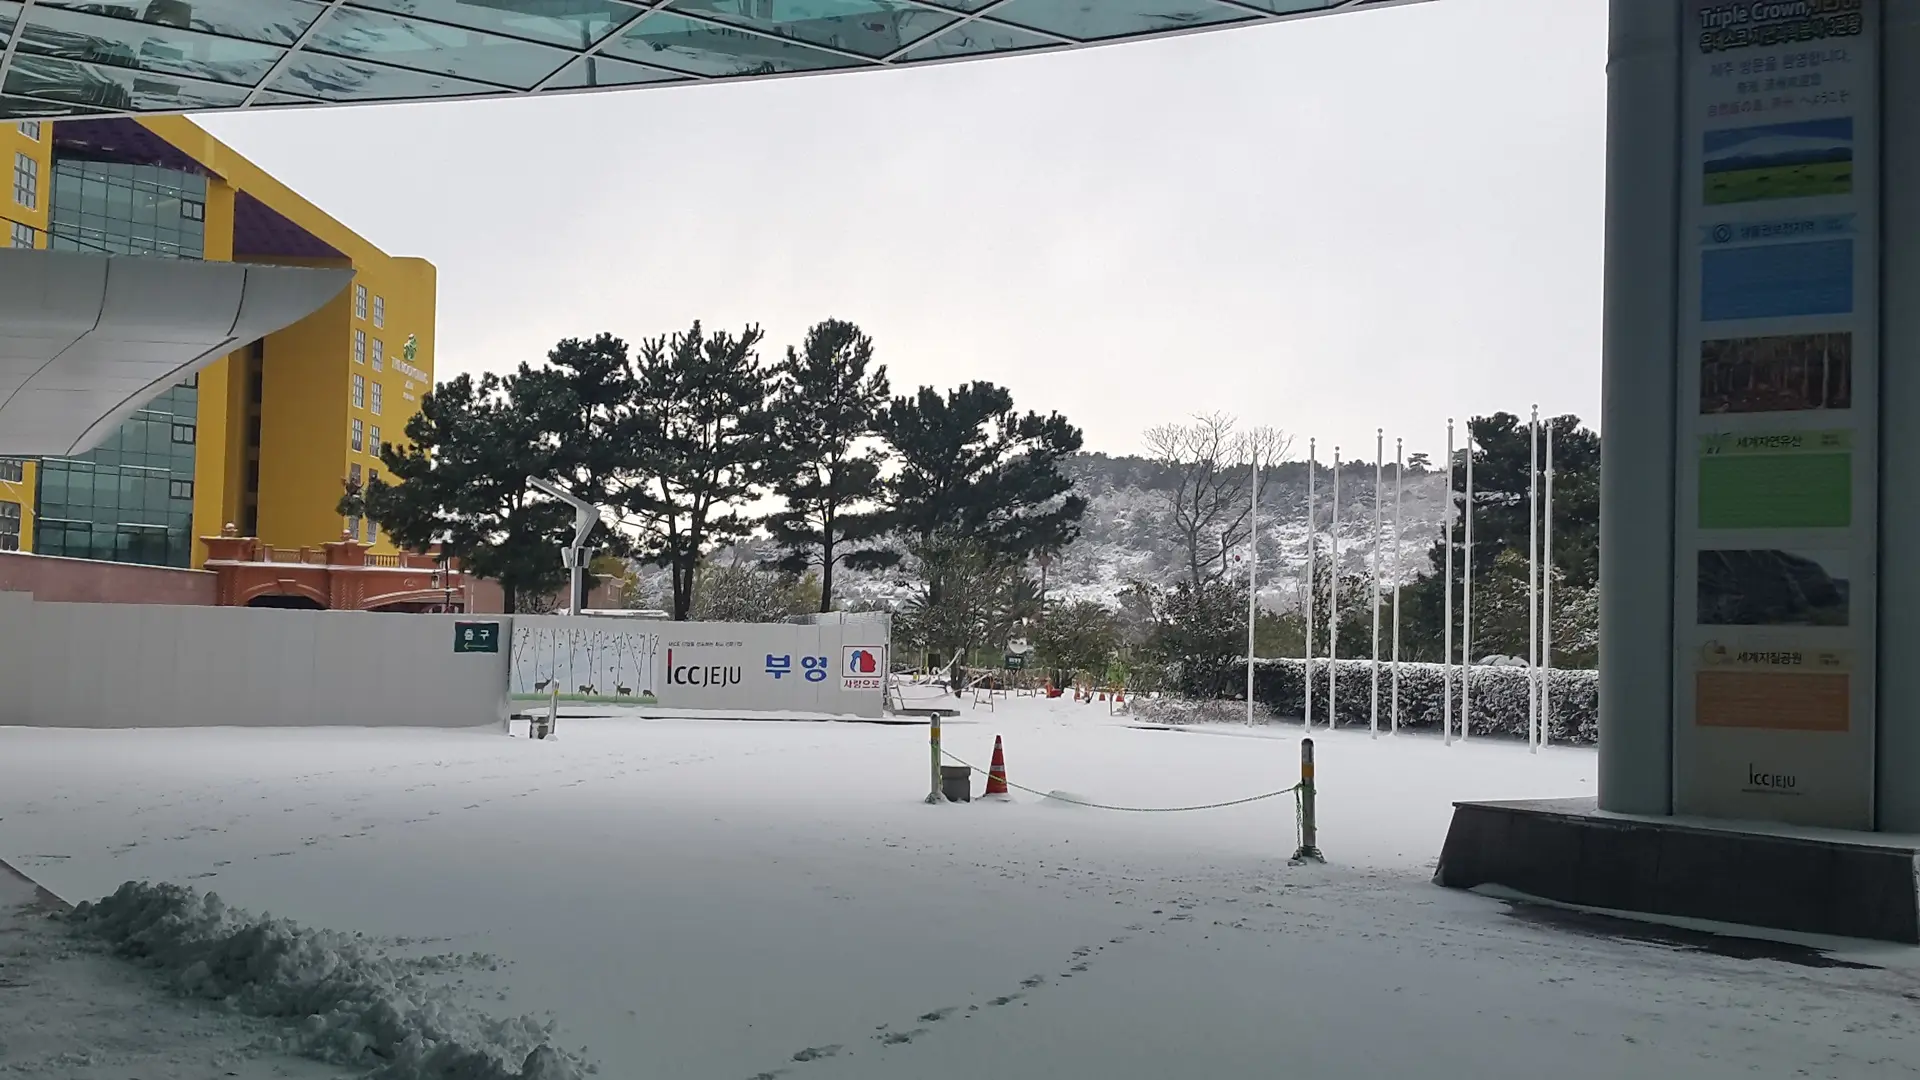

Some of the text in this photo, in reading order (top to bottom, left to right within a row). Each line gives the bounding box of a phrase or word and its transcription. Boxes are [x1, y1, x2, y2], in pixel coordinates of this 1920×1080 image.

[1701, 5, 1748, 28] Triple
[1751, 2, 1811, 21] Crown,
[1736, 434, 1803, 448] 세계자연유산
[1736, 652, 1803, 665] 세계지질공원
[843, 679, 880, 689] 사랑으로
